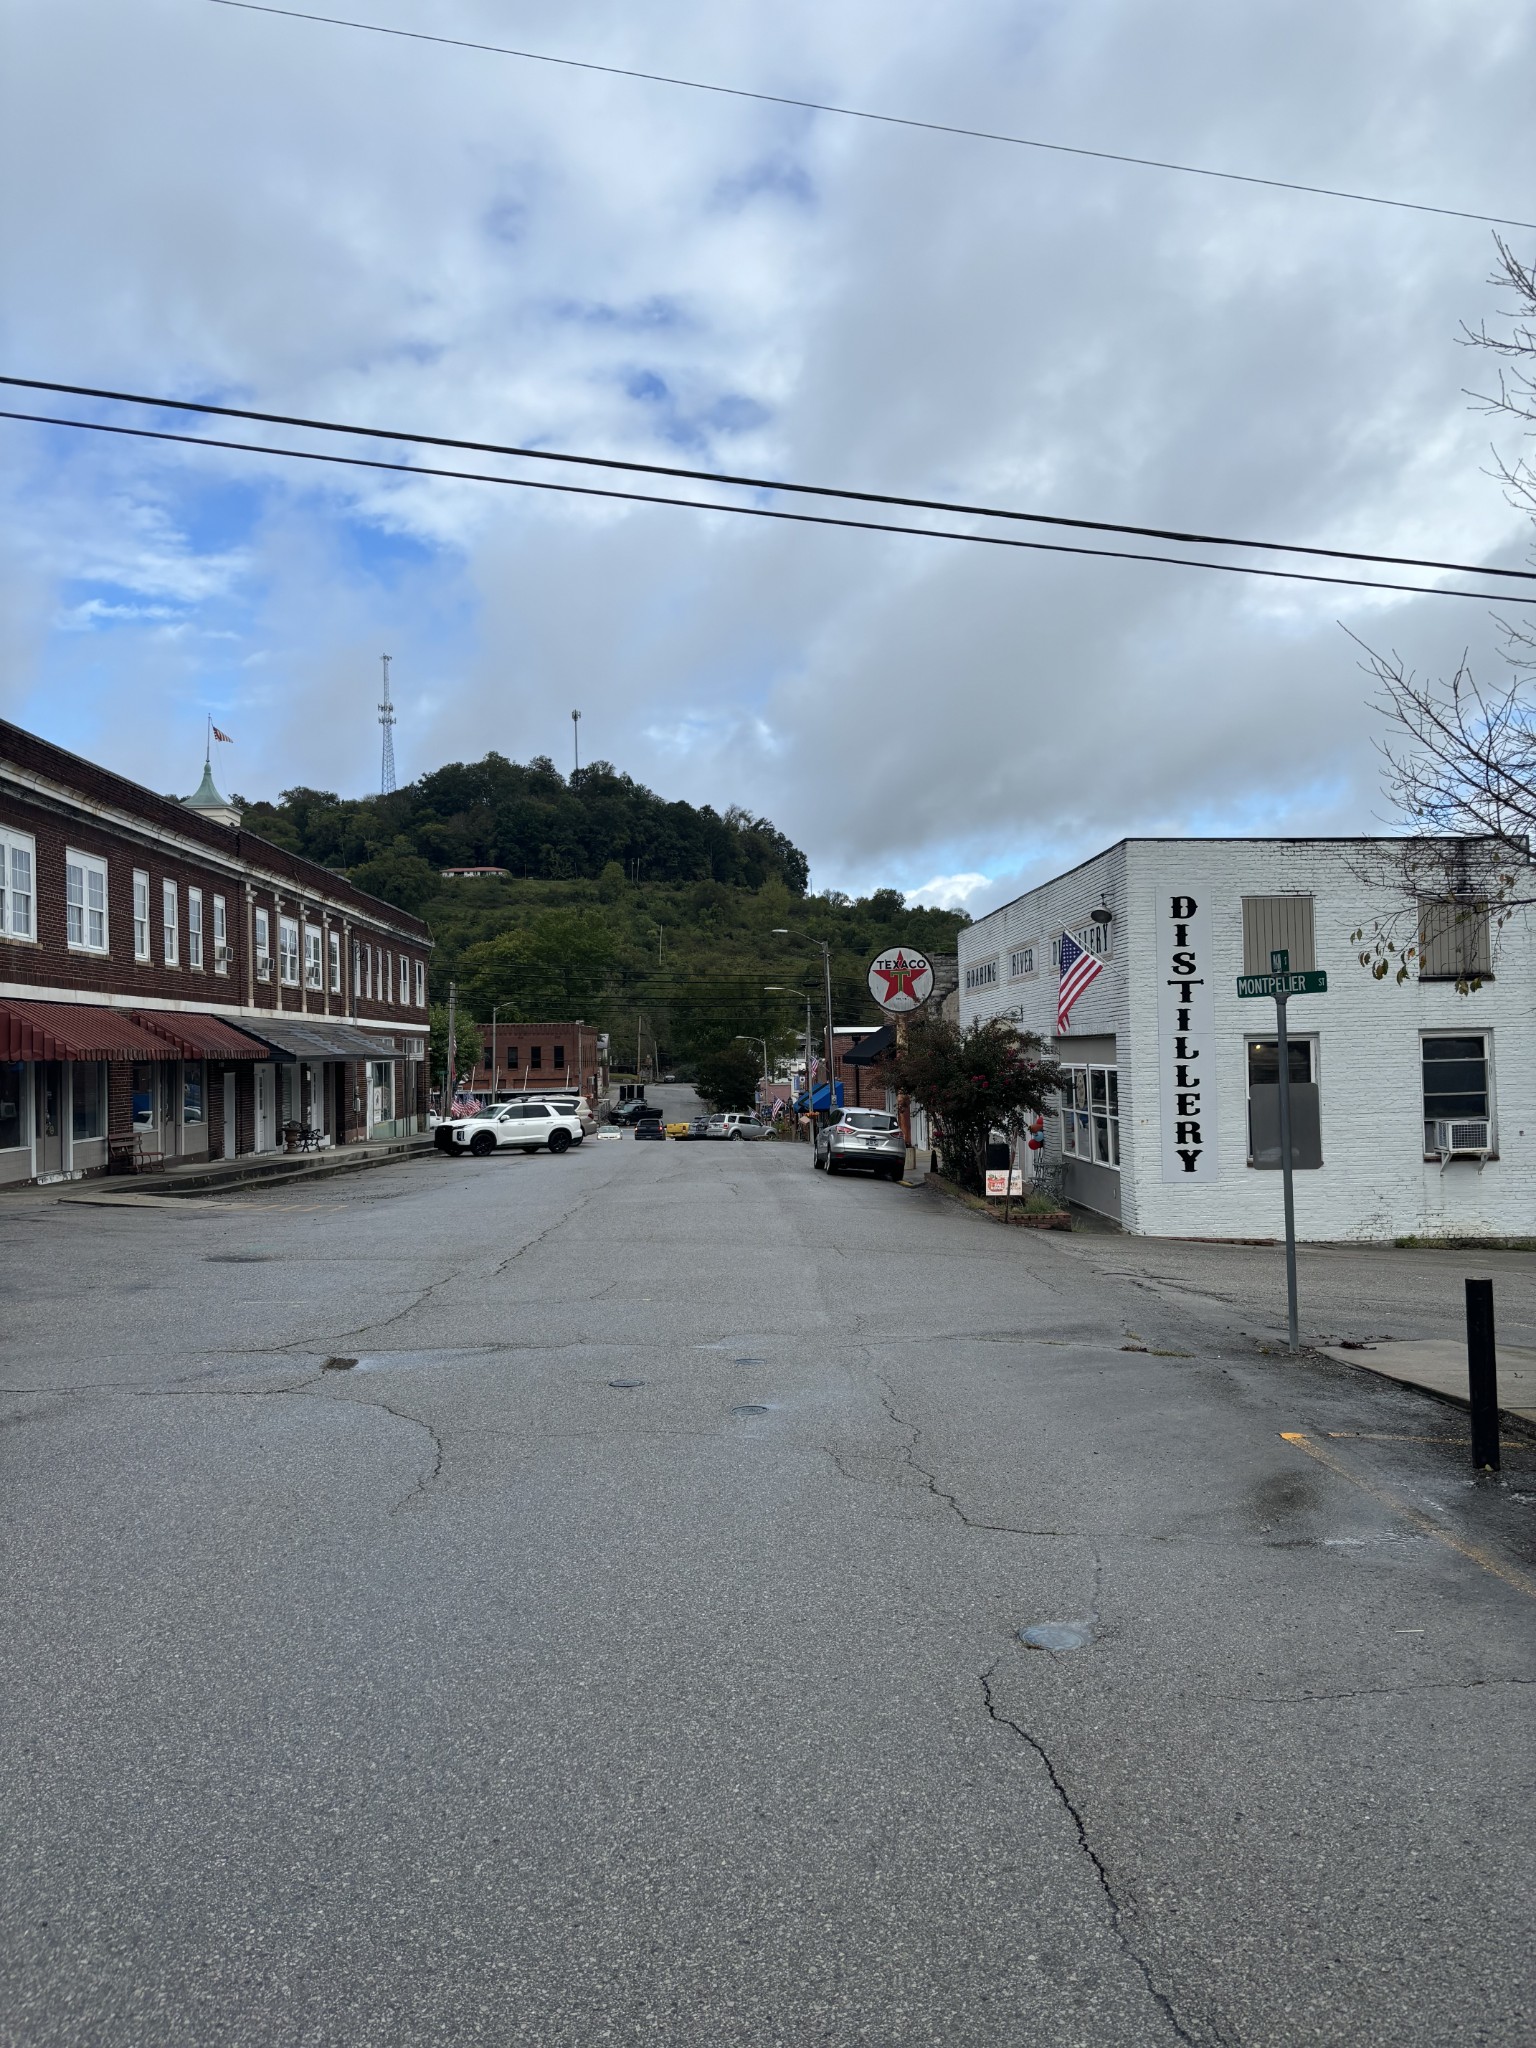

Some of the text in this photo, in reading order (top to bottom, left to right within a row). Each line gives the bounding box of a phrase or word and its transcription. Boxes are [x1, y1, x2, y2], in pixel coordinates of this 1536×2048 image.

[877, 959, 927, 970] TEXACO
[966, 962, 997, 989] ROARING
[1012, 949, 1034, 977] RIVER
[890, 970, 911, 992] T
[1238, 975, 1325, 995] MONTPELIER ST
[1167, 896, 1204, 1172] DISTILLERY
